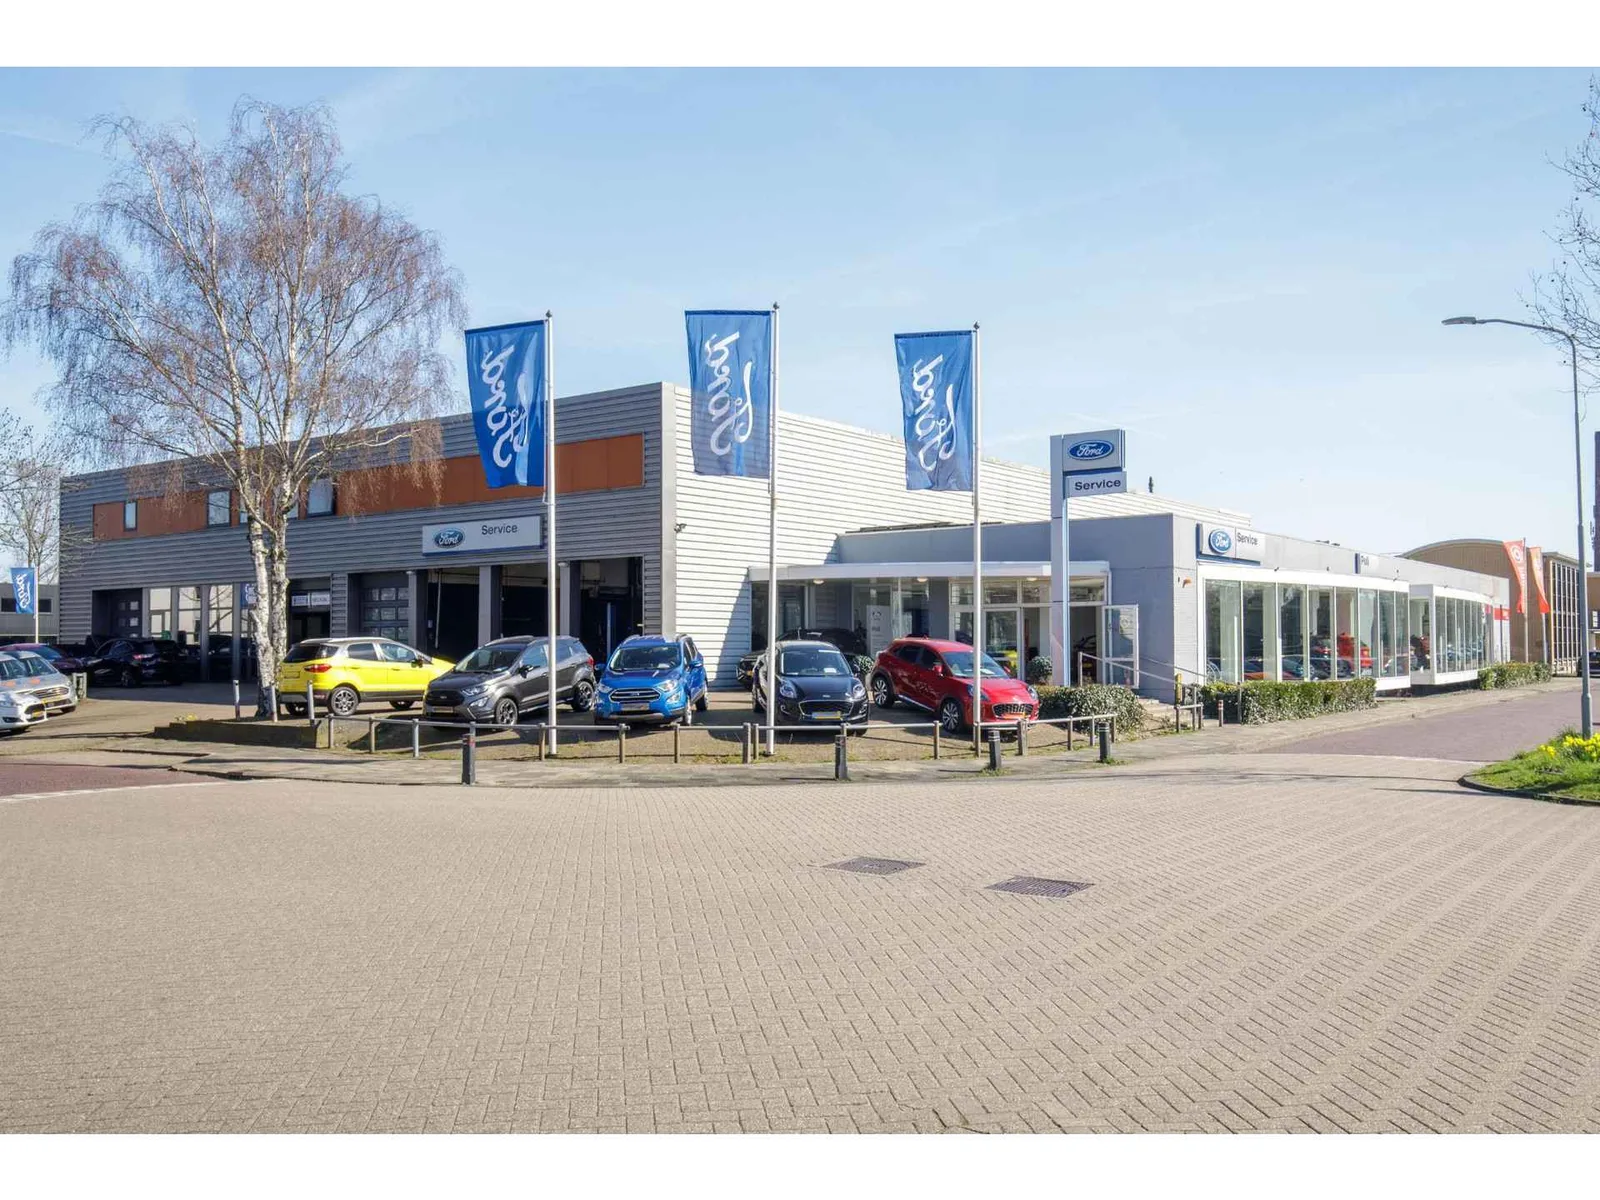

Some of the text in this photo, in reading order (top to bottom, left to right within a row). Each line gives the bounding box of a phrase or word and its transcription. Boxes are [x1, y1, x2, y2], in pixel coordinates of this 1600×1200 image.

[1076, 443, 1105, 457] Ford
[1074, 479, 1122, 491] Service
[481, 524, 518, 536] Service
[438, 530, 461, 546] Ford
[1215, 531, 1230, 549] Ford
[1236, 532, 1259, 546] Service
